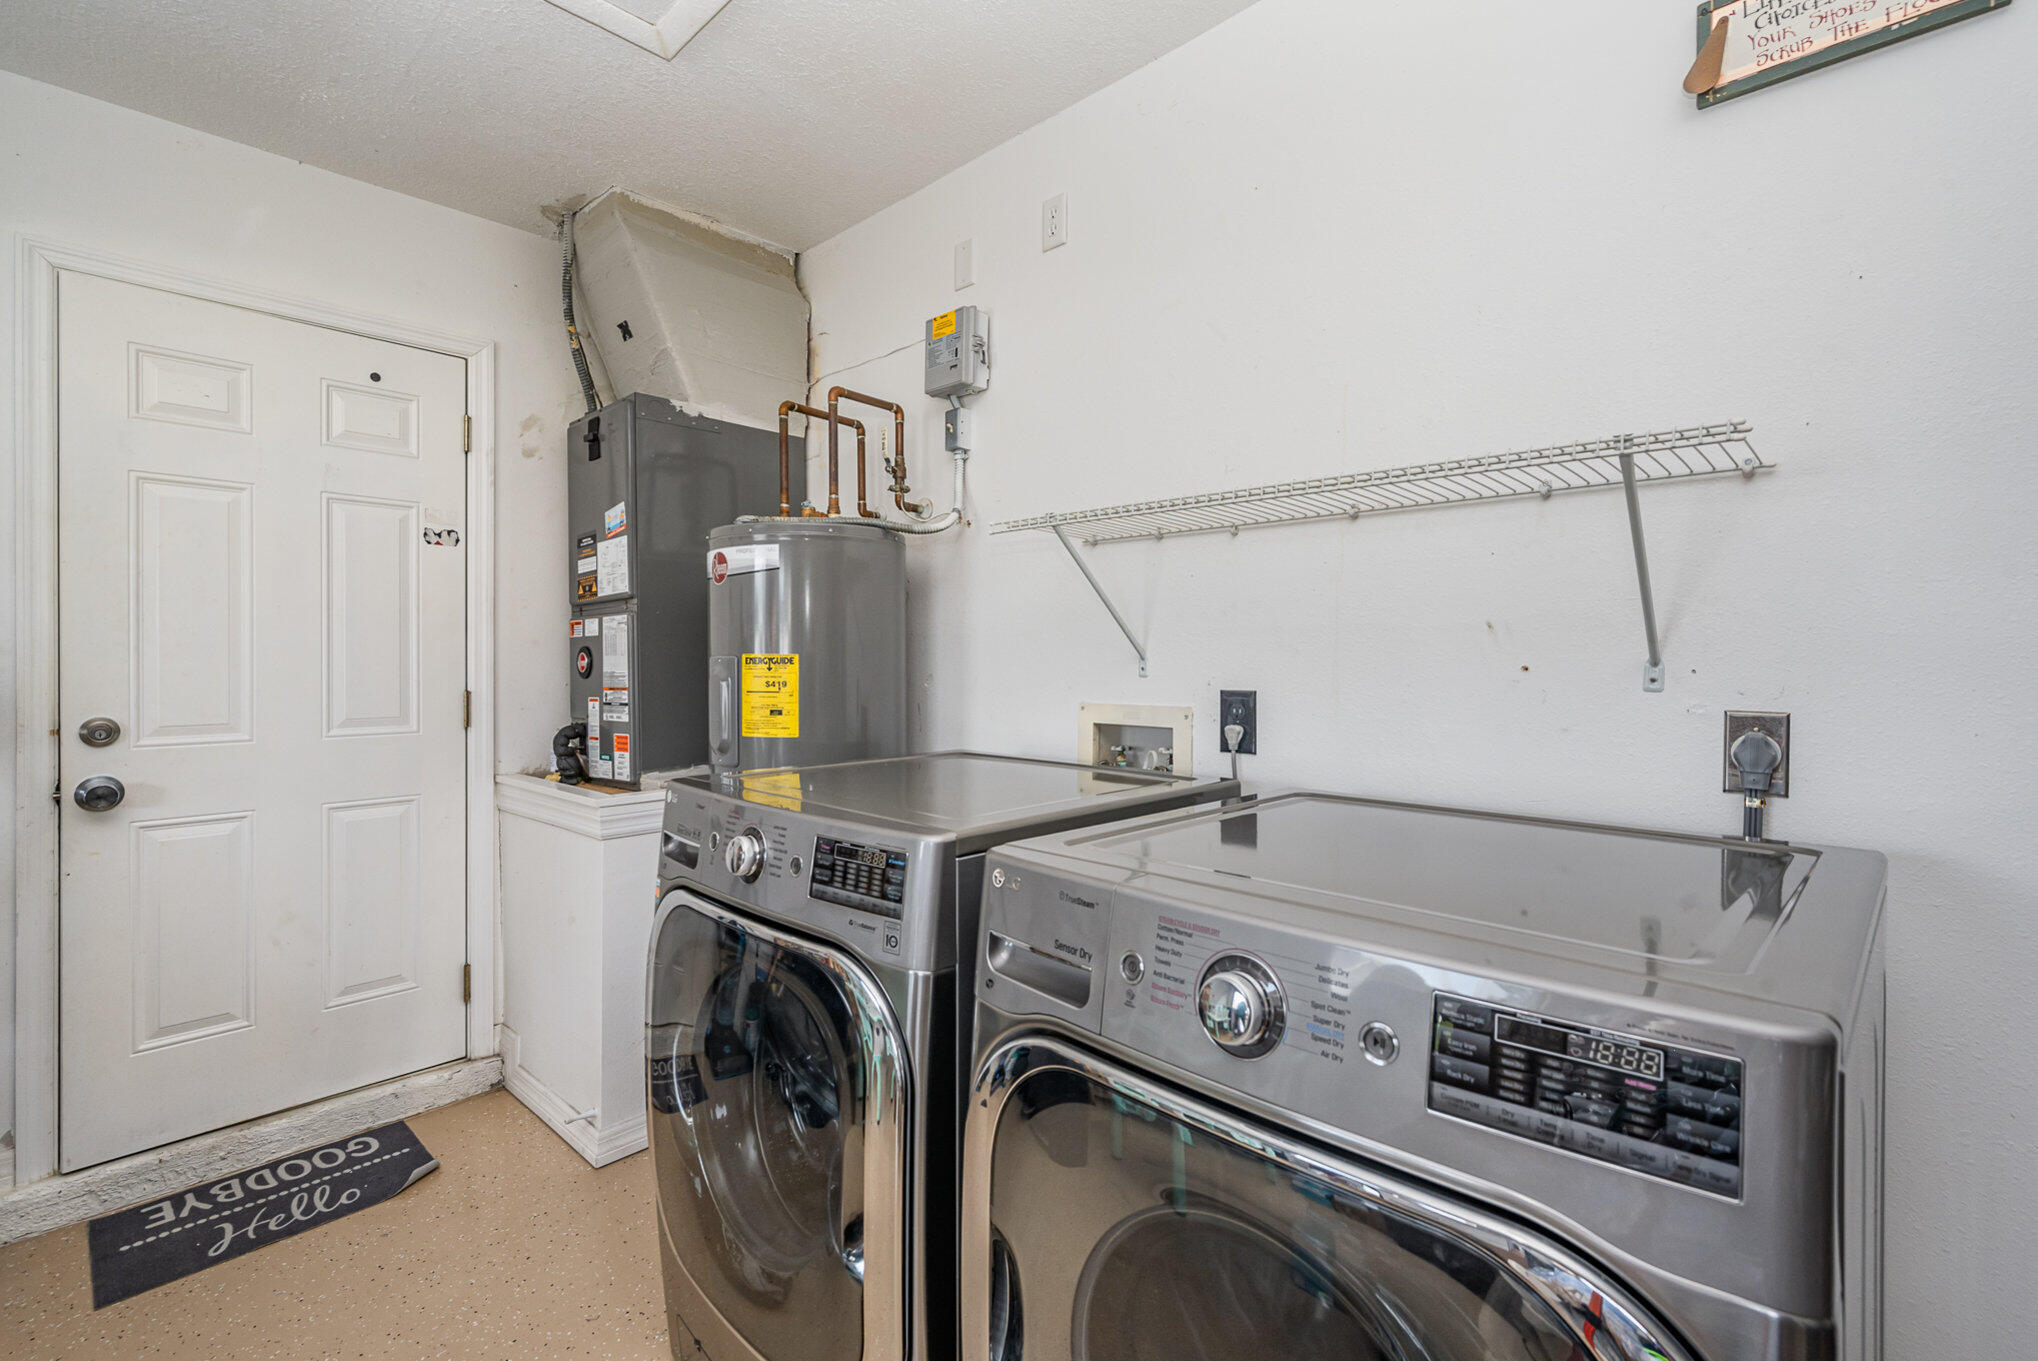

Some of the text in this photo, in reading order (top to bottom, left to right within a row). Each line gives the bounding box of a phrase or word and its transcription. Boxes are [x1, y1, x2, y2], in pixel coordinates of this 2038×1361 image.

[1747, 0, 1877, 50] YOUR SHOES
[1756, 36, 1814, 67] SCRUB
[1827, 19, 1870, 41] THE
[1054, 938, 1094, 963] Sensor Dry
[1337, 968, 1350, 978] Dry
[1332, 1020, 1345, 1031] Dry
[1320, 1049, 1344, 1064] Air Dry
[1332, 1038, 1344, 1050] Dry
[140, 1136, 380, 1229] GOODBYE
[207, 1185, 361, 1257] Hello
